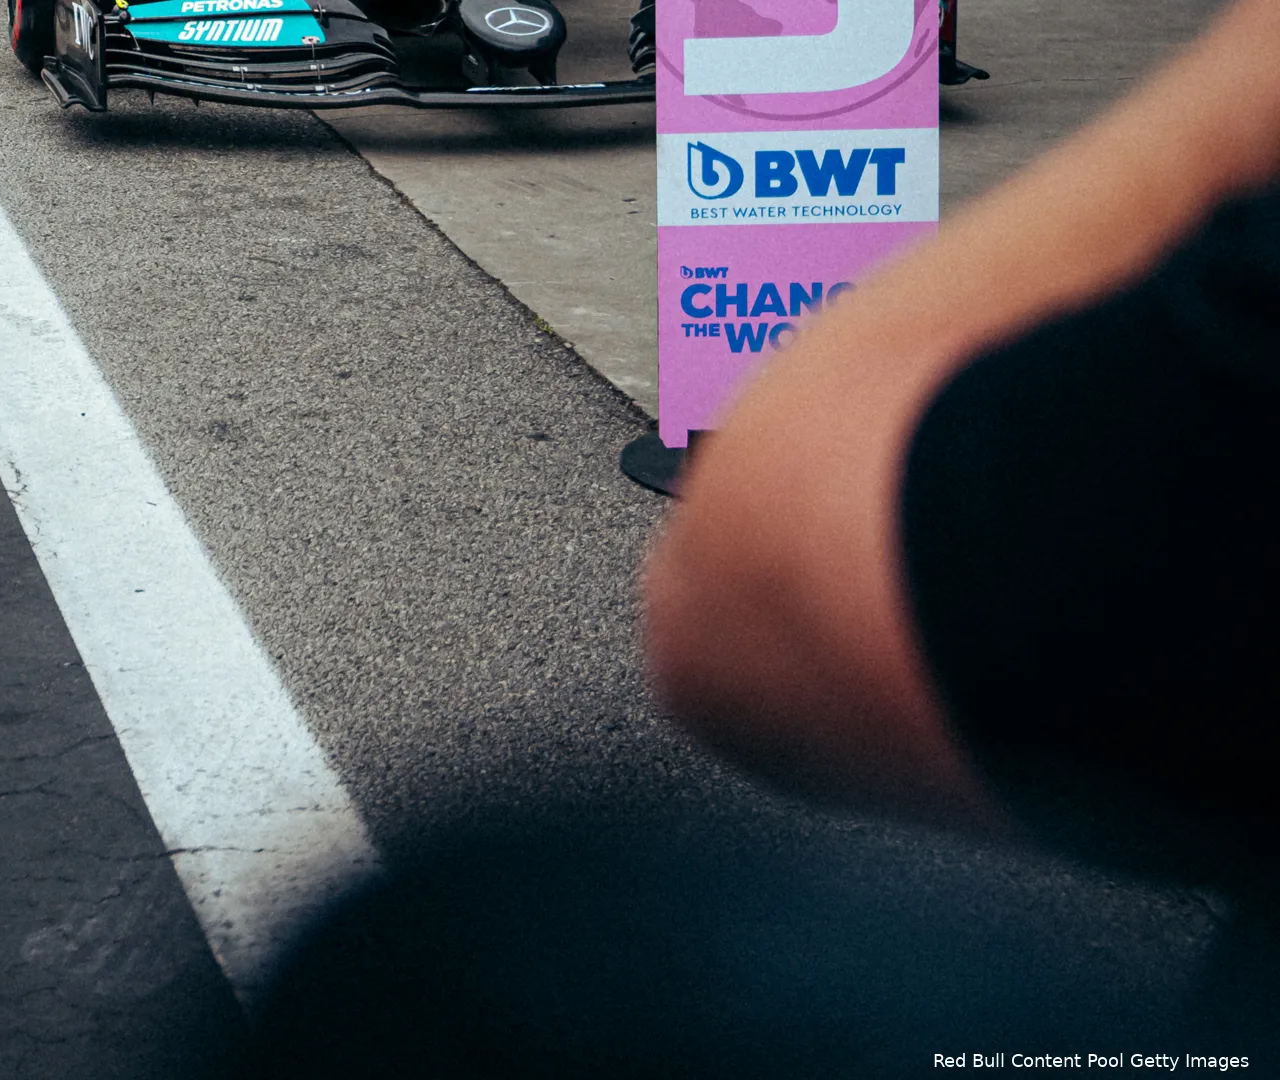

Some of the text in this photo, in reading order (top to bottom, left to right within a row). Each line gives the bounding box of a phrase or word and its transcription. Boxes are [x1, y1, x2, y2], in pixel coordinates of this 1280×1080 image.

[178, 18, 284, 42] SYNTIUM
[754, 147, 906, 198] BWT
[690, 204, 902, 219] BEST WATER TECHNOLOGY
[694, 266, 729, 279] BWT
[680, 281, 856, 318] CHAN
[681, 323, 721, 337] THE
